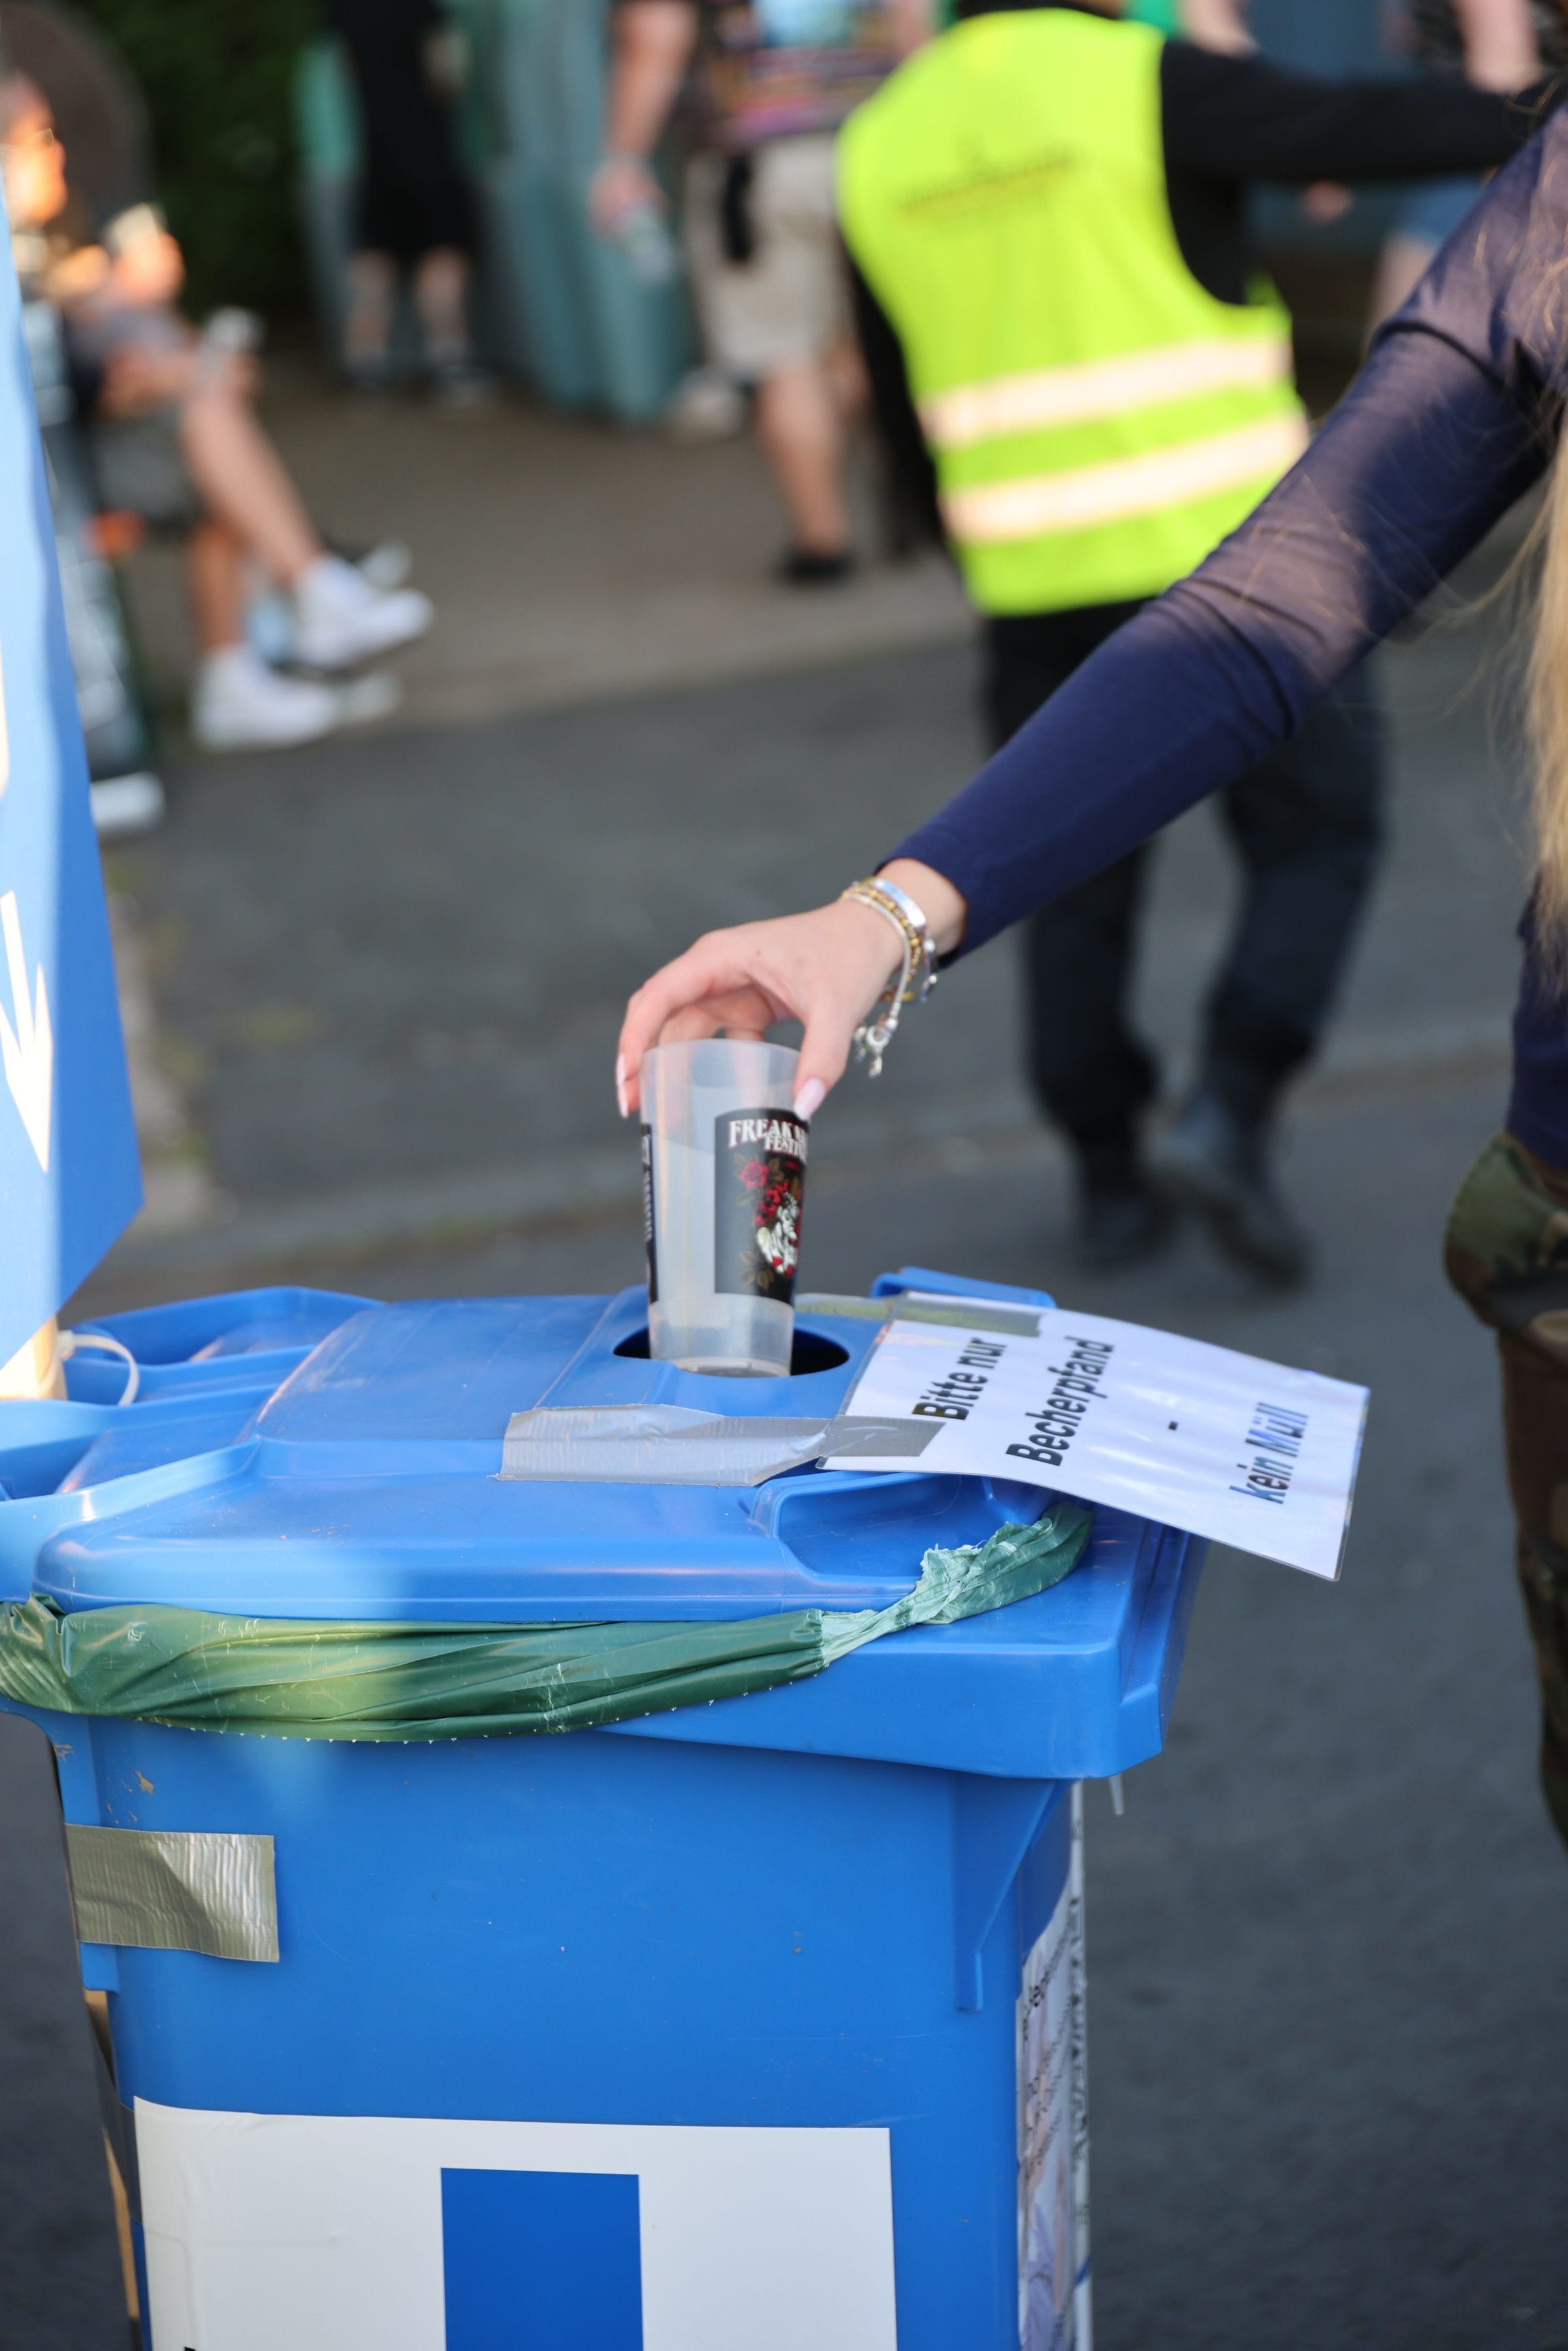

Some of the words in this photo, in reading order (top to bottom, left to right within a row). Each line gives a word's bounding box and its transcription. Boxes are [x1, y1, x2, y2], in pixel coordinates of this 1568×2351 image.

[728, 1118, 792, 1148] FREAK
[911, 1372, 988, 1421] Bitte
[956, 1337, 1007, 1369] nur
[1005, 1336, 1115, 1466] Becherpfand
[1245, 1402, 1309, 1458] Müll
[1229, 1456, 1294, 1504] kein
